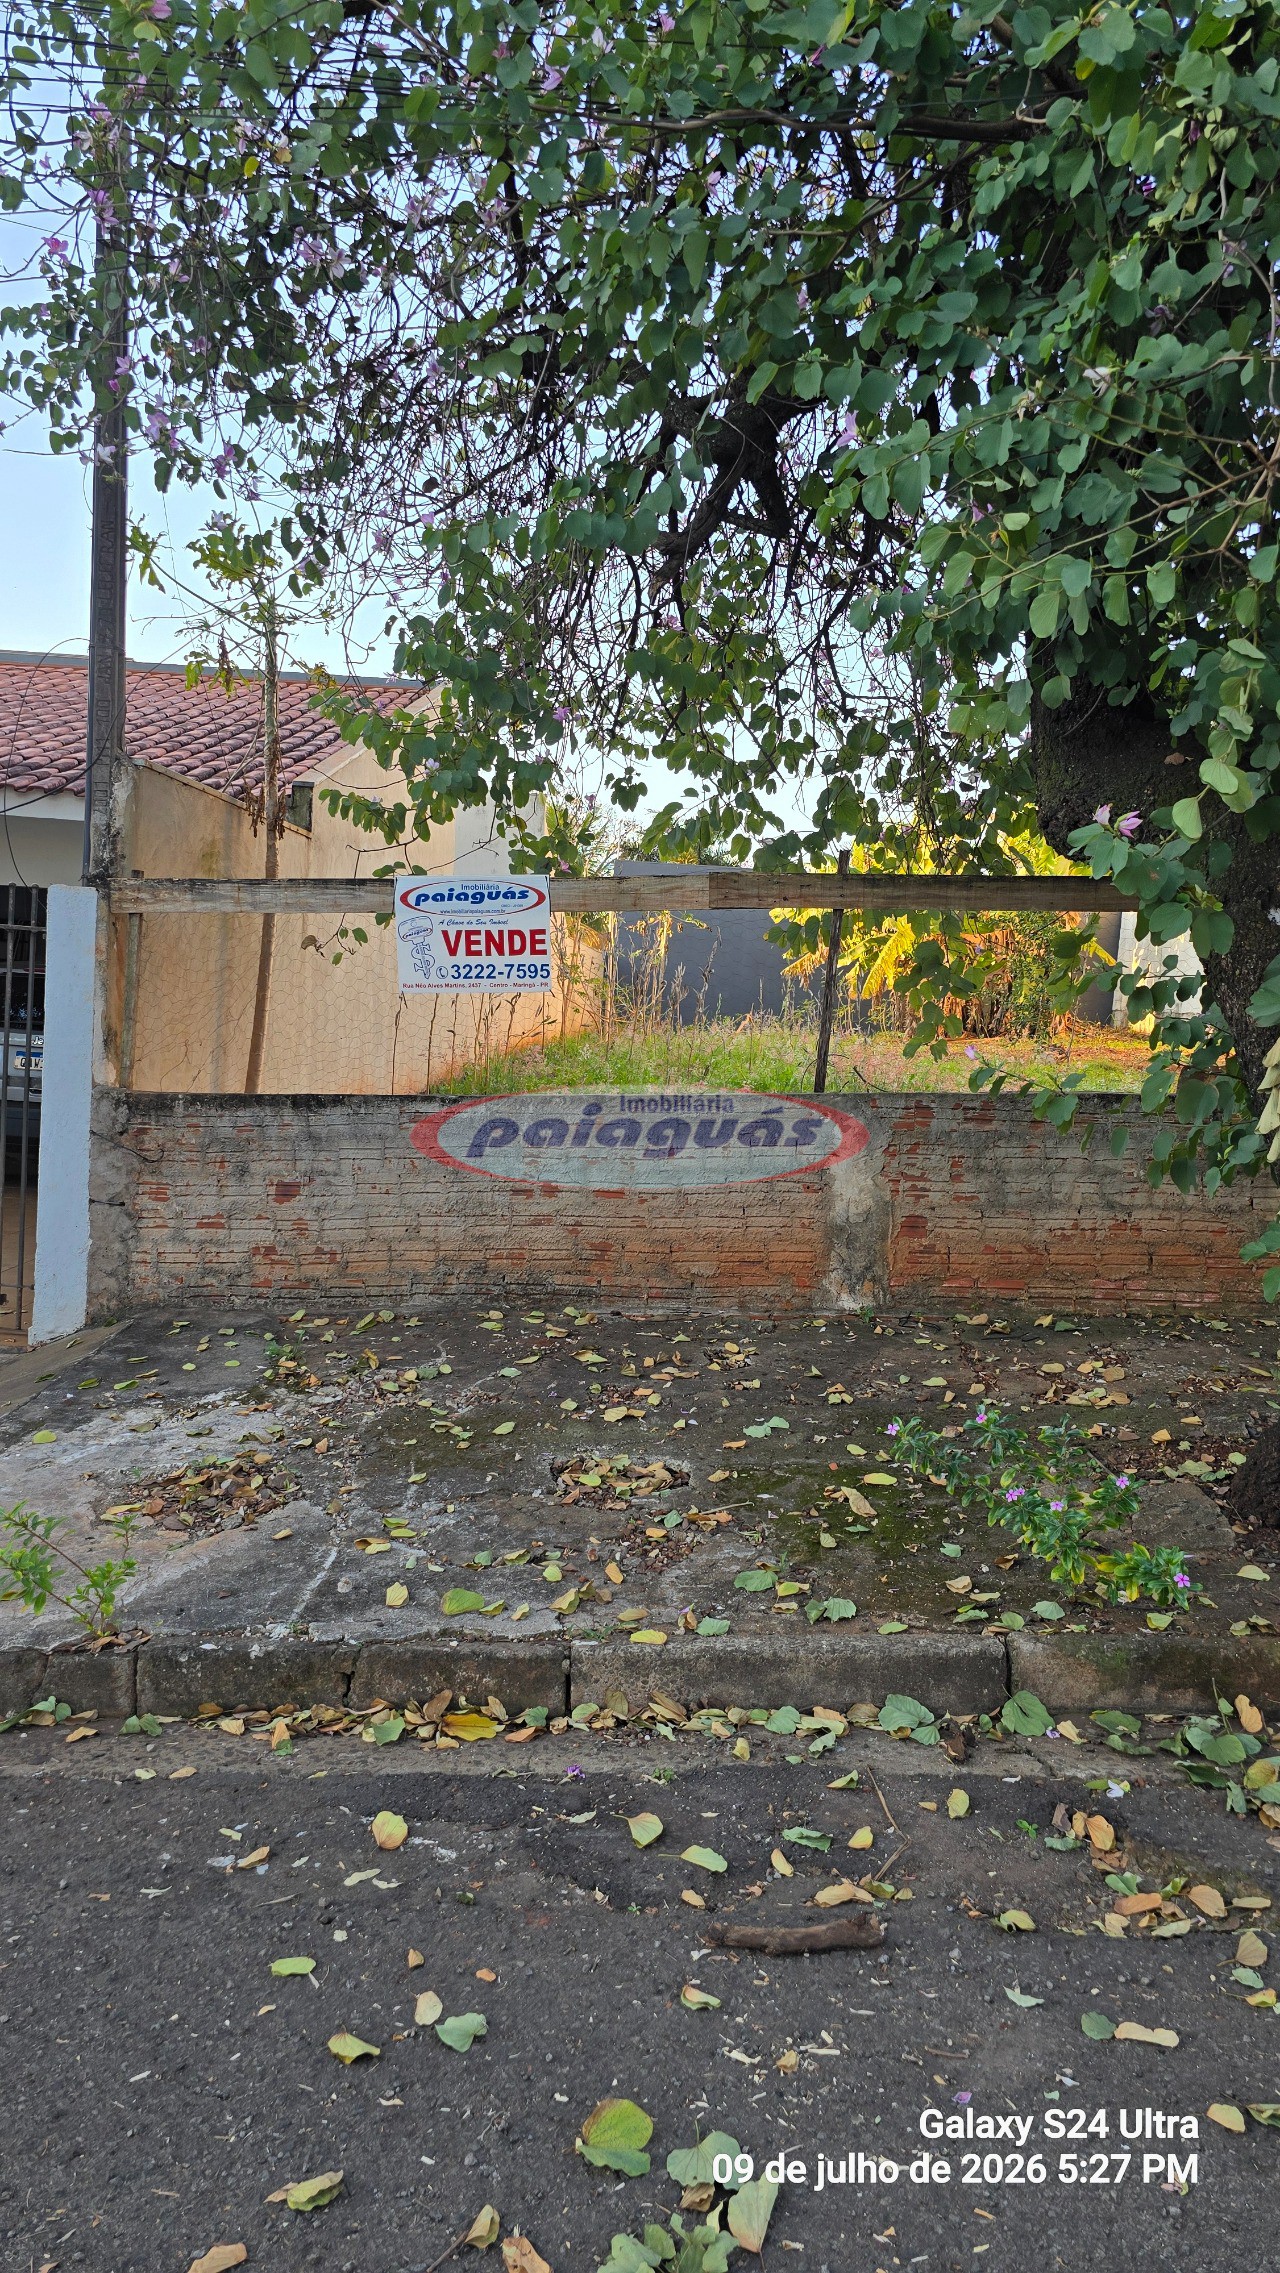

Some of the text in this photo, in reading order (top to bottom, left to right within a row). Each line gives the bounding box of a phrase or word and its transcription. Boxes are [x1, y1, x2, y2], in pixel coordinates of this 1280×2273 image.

[461, 882, 500, 891] Imobiliária
[414, 887, 530, 907] paiaguás
[441, 929, 548, 957] VENDE
[451, 963, 551, 980] 3222-7595
